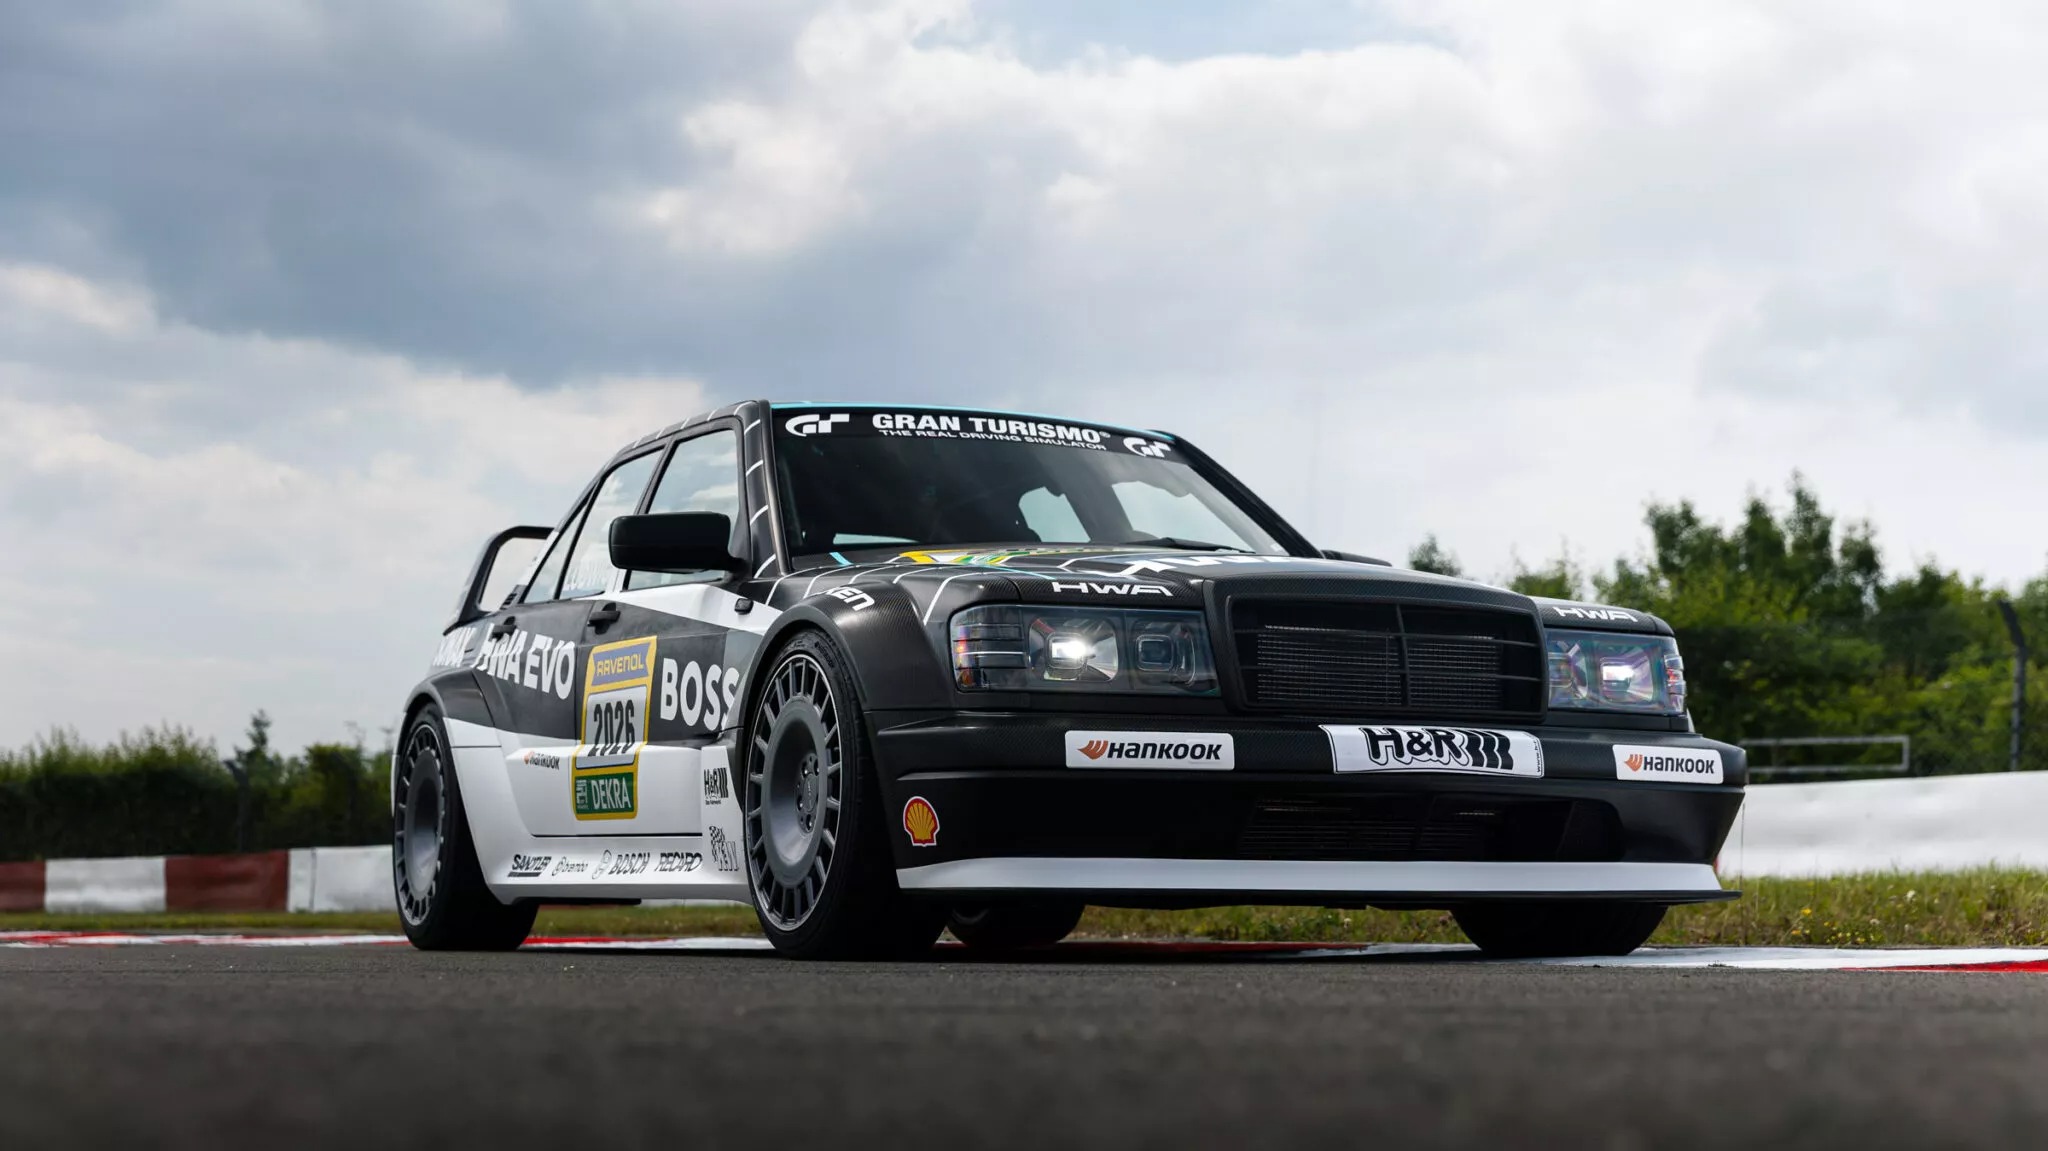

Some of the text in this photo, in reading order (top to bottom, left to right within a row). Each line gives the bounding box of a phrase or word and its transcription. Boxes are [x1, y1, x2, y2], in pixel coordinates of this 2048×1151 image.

[872, 413, 961, 431] GRAN
[915, 430, 957, 438] REAL
[959, 431, 1022, 442] DRIVING
[1026, 436, 1108, 451] SIMULATOR
[1051, 581, 1174, 597] HWA
[1552, 606, 1639, 623] HWA
[523, 633, 576, 700] EVO
[596, 653, 645, 677] RAVENOL
[660, 657, 740, 732] BOSS
[587, 699, 636, 757] 2026
[591, 776, 632, 810] DEKRA
[608, 852, 650, 875] BOSCH
[654, 851, 704, 873] RECARO
